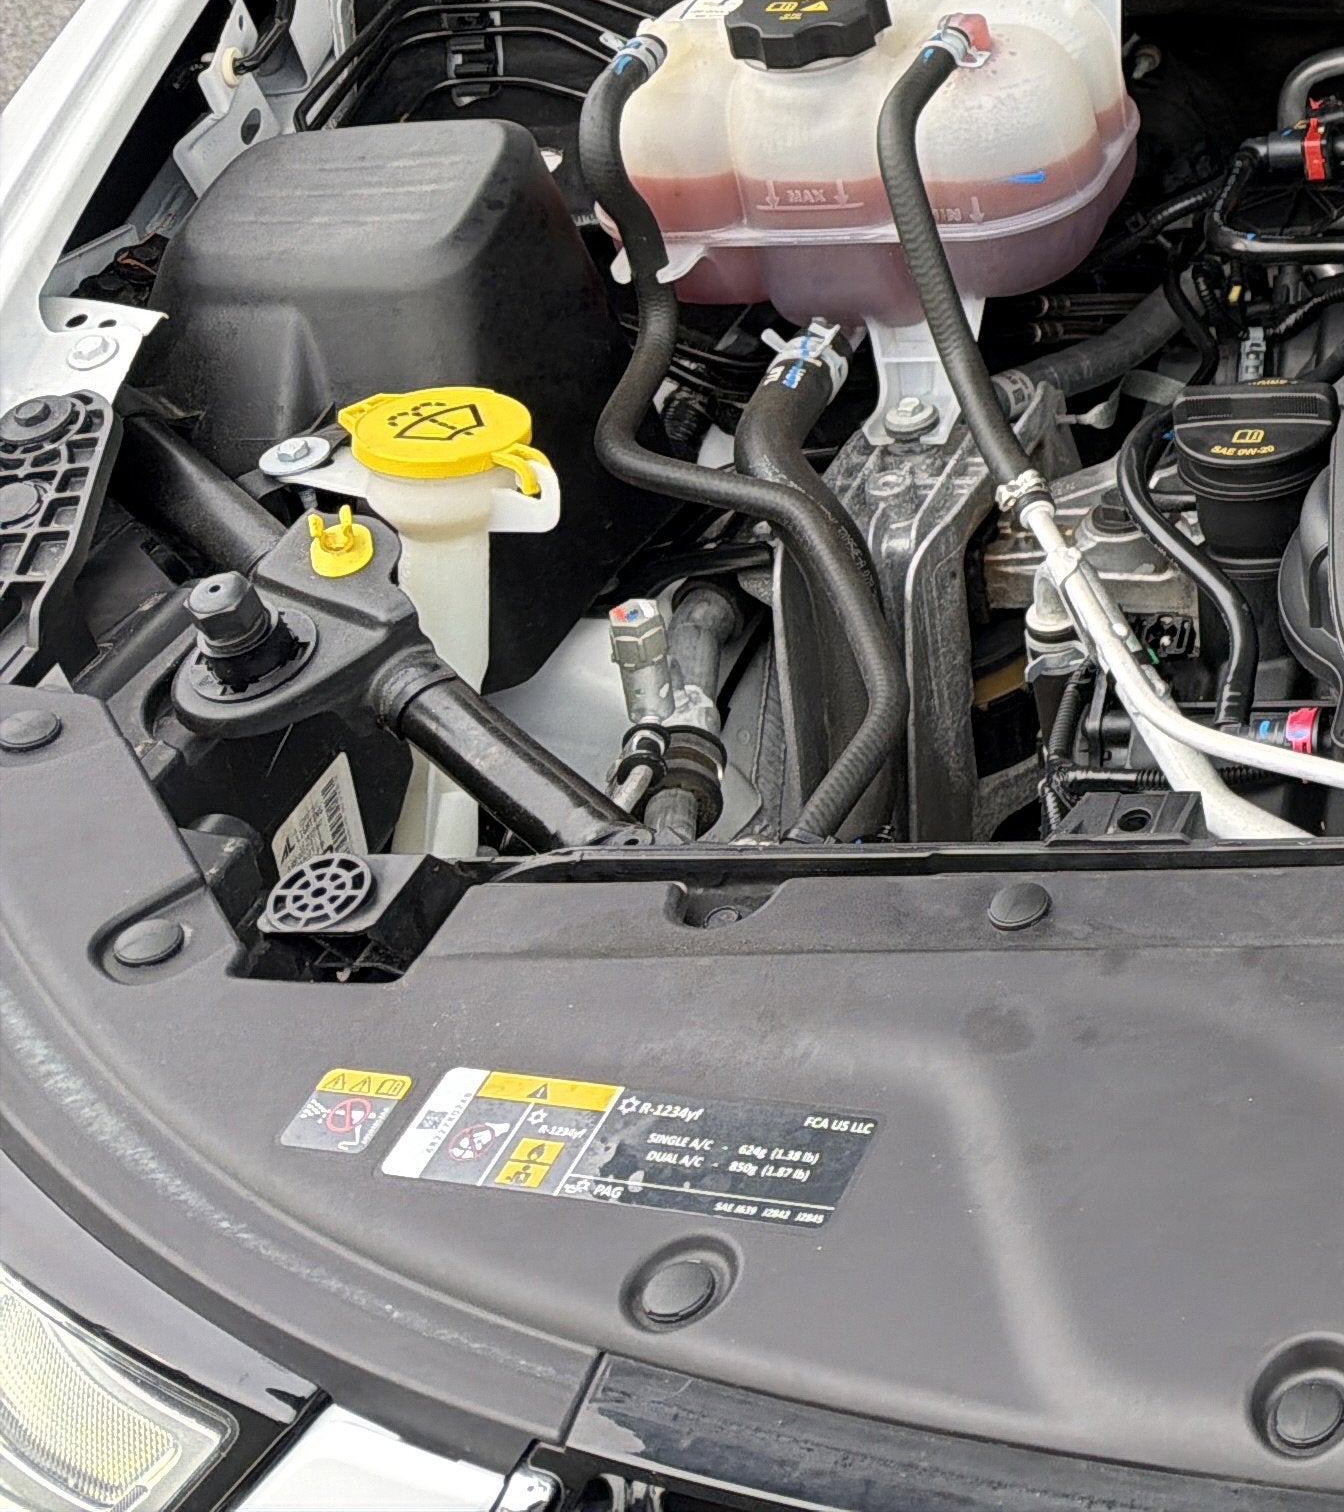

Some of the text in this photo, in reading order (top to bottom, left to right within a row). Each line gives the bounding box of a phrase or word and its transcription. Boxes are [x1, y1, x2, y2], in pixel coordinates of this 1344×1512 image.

[786, 189, 826, 203] MAX
[1210, 445, 1275, 456] SAE 0W-20
[638, 1102, 704, 1123] R-1234yf
[803, 1116, 875, 1135] FCA US LLC
[647, 1133, 691, 1149] SINGLE
[690, 1137, 715, 1151] A/C
[738, 1144, 768, 1160] 624g
[770, 1148, 801, 1163] (1.38
[801, 1150, 820, 1165] lb)
[646, 1150, 678, 1166] DUAL
[681, 1154, 705, 1169] A/C
[728, 1161, 758, 1177] 850g
[760, 1164, 792, 1179] (1.87
[792, 1167, 811, 1183] lb)
[593, 1184, 624, 1199] PAG
[713, 1202, 734, 1213] SAE
